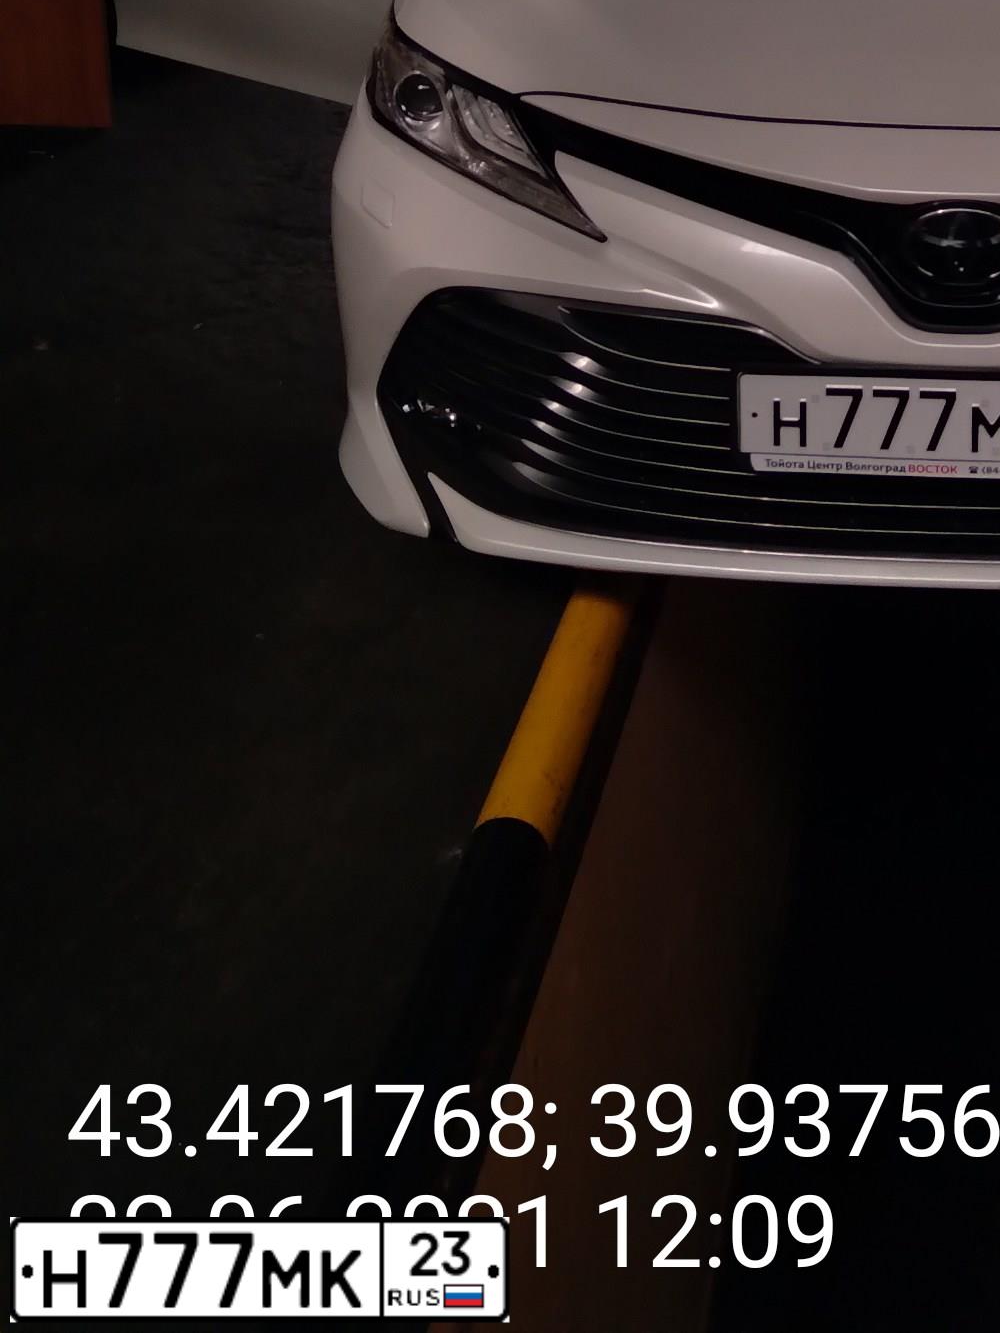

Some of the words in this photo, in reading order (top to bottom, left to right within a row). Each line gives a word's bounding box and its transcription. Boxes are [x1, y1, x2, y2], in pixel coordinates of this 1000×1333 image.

[765, 458, 804, 470] Тойота
[807, 460, 843, 473] Центр
[845, 462, 906, 475] Волгоград
[908, 464, 958, 475] ВОСТОК
